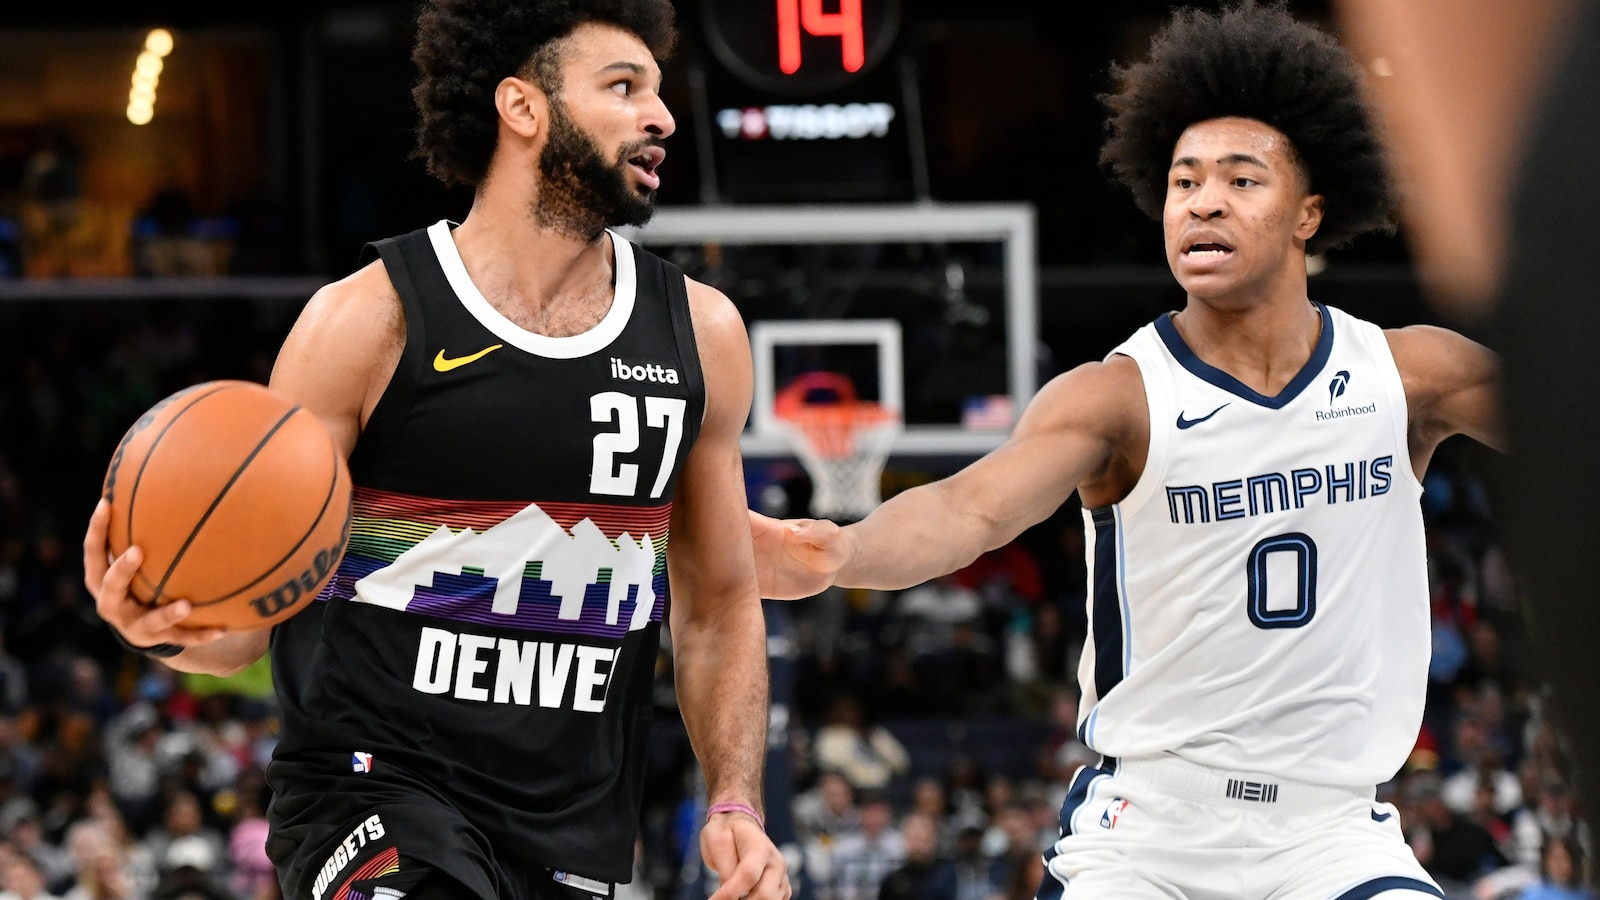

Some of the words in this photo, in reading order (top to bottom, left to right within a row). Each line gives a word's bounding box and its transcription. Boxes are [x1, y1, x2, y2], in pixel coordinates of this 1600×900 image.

[777, 0, 865, 74] 14
[610, 357, 679, 384] ibotta
[589, 391, 687, 499] 27
[1315, 402, 1376, 421] Robinhood
[1165, 455, 1393, 524] MEMPHIS
[1246, 532, 1318, 630] 0
[412, 626, 622, 713] DENVE
